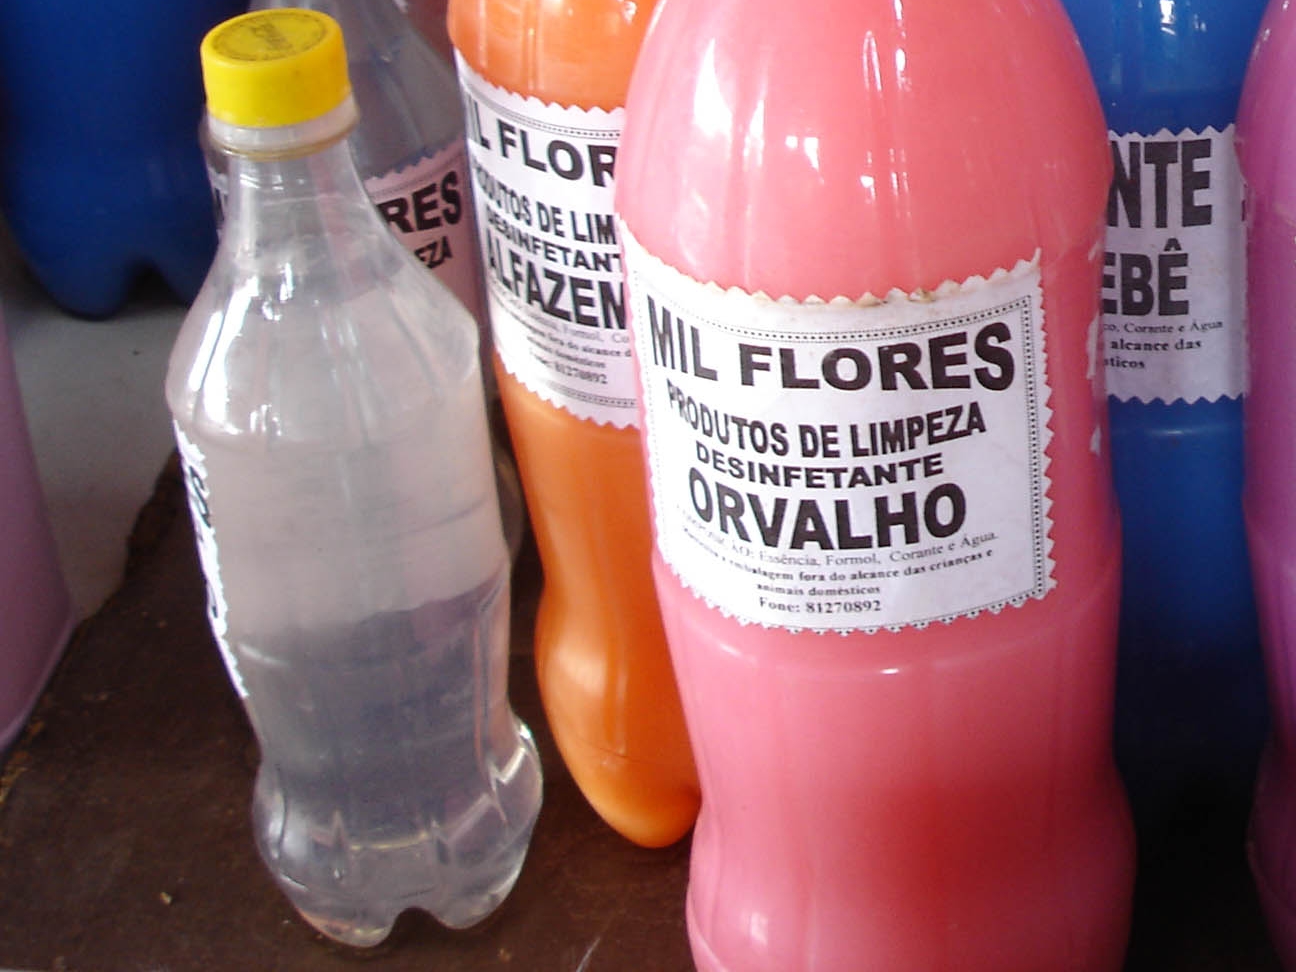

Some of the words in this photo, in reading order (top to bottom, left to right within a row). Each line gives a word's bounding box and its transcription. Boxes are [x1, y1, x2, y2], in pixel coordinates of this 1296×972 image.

[537, 201, 565, 238] DE
[570, 211, 618, 245] LIM
[646, 294, 719, 382] MIL
[738, 322, 1015, 392] FLORES
[1110, 338, 1169, 351] alcance
[1174, 338, 1202, 351] das
[666, 378, 790, 456] PRODUTOS
[799, 424, 840, 458] DE
[849, 402, 987, 458] LIMPEZA
[695, 440, 944, 490] DESINFETANTE
[688, 466, 967, 551] ORVALHO
[799, 571, 826, 582] fora
[829, 571, 846, 581] do
[851, 569, 900, 580] alcance
[904, 565, 927, 577] das
[929, 554, 983, 572] crianças
[986, 549, 993, 557] e
[889, 546, 944, 563] Corante
[948, 543, 955, 551] e
[757, 583, 804, 596] animais
[808, 585, 881, 597] domésticos
[759, 596, 800, 612] Fone:
[805, 600, 882, 614] 81270892
